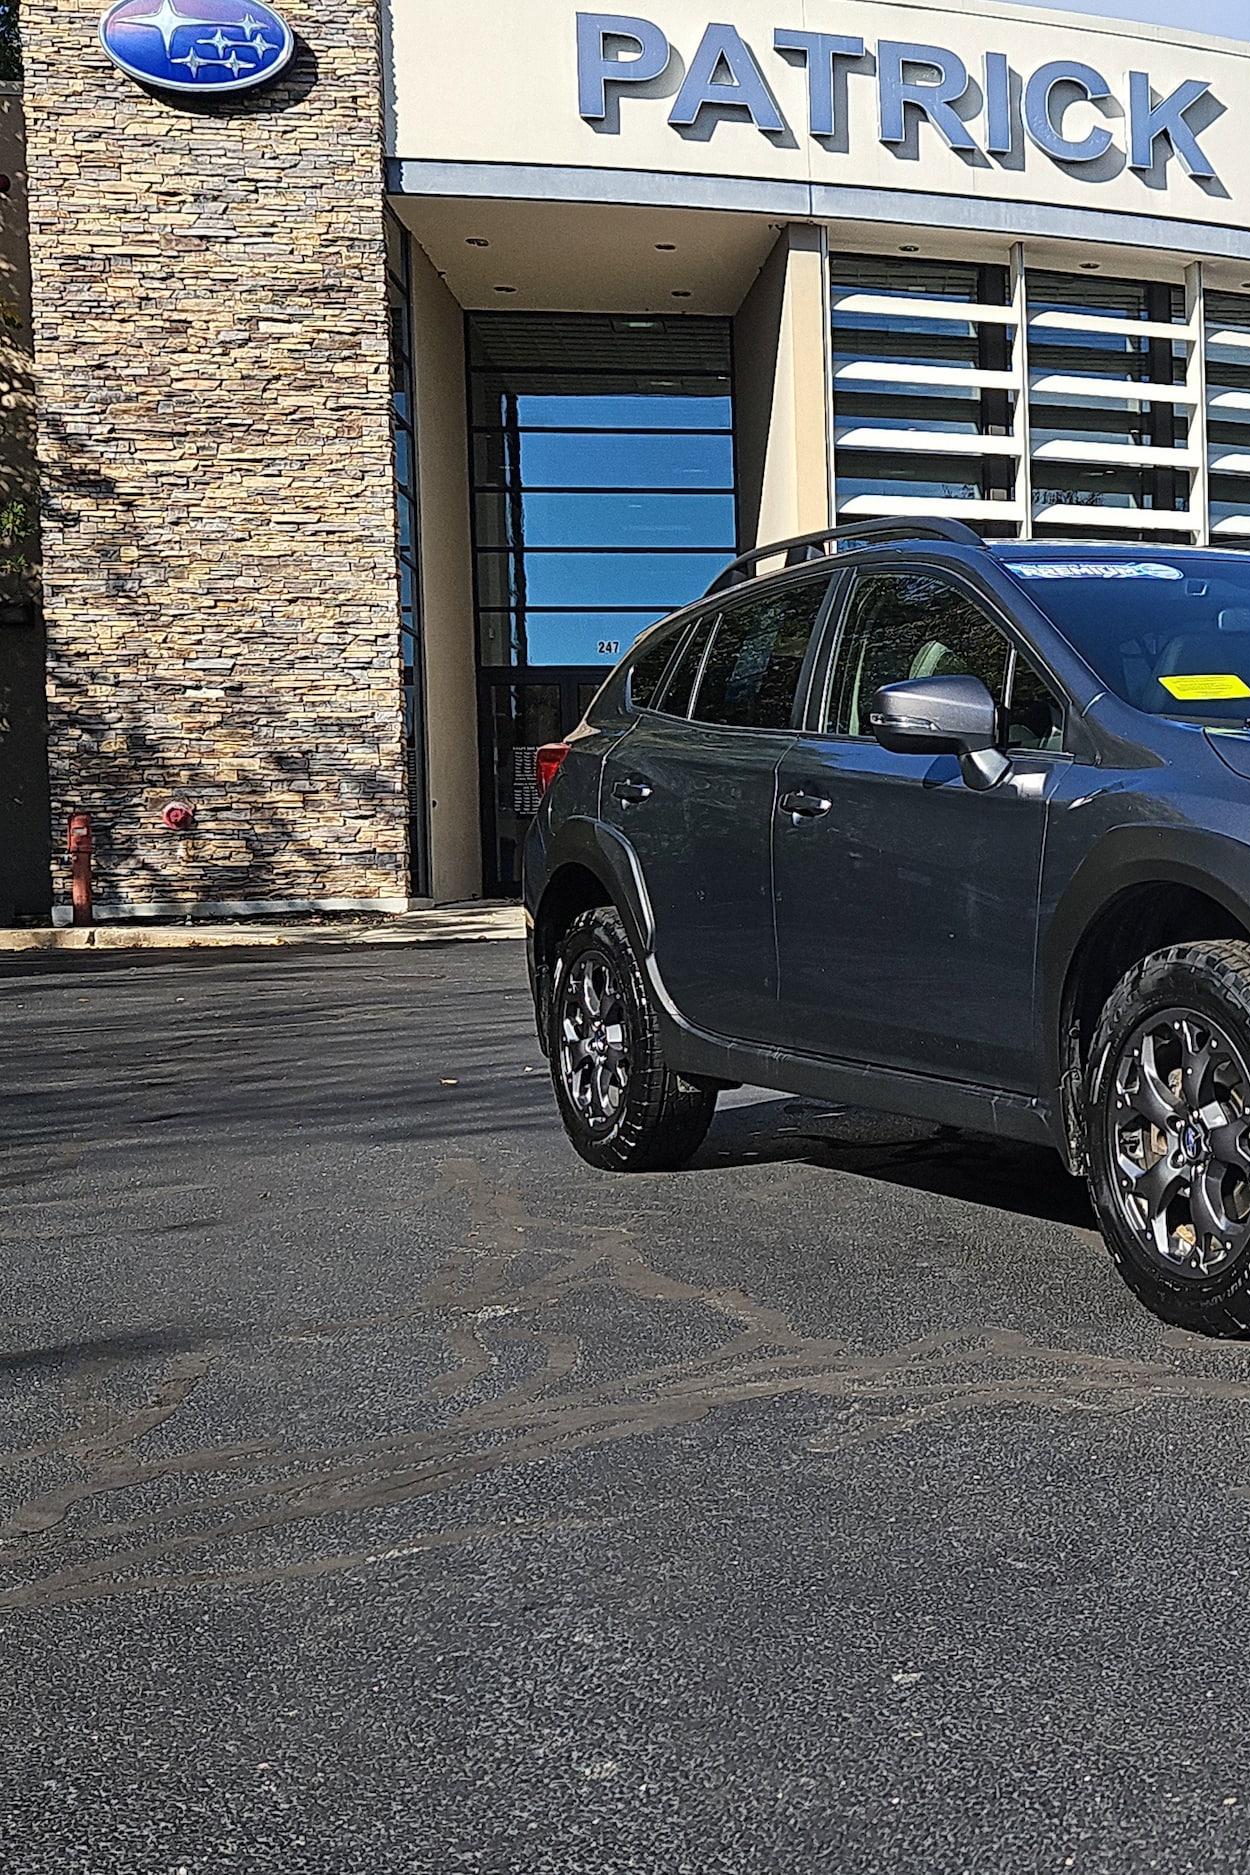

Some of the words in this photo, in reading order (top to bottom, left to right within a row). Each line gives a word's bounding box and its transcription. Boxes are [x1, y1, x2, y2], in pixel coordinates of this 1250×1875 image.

[576, 12, 1216, 180] PATRICK
[1019, 563, 1140, 579] PREMIUM
[598, 641, 619, 654] 247
